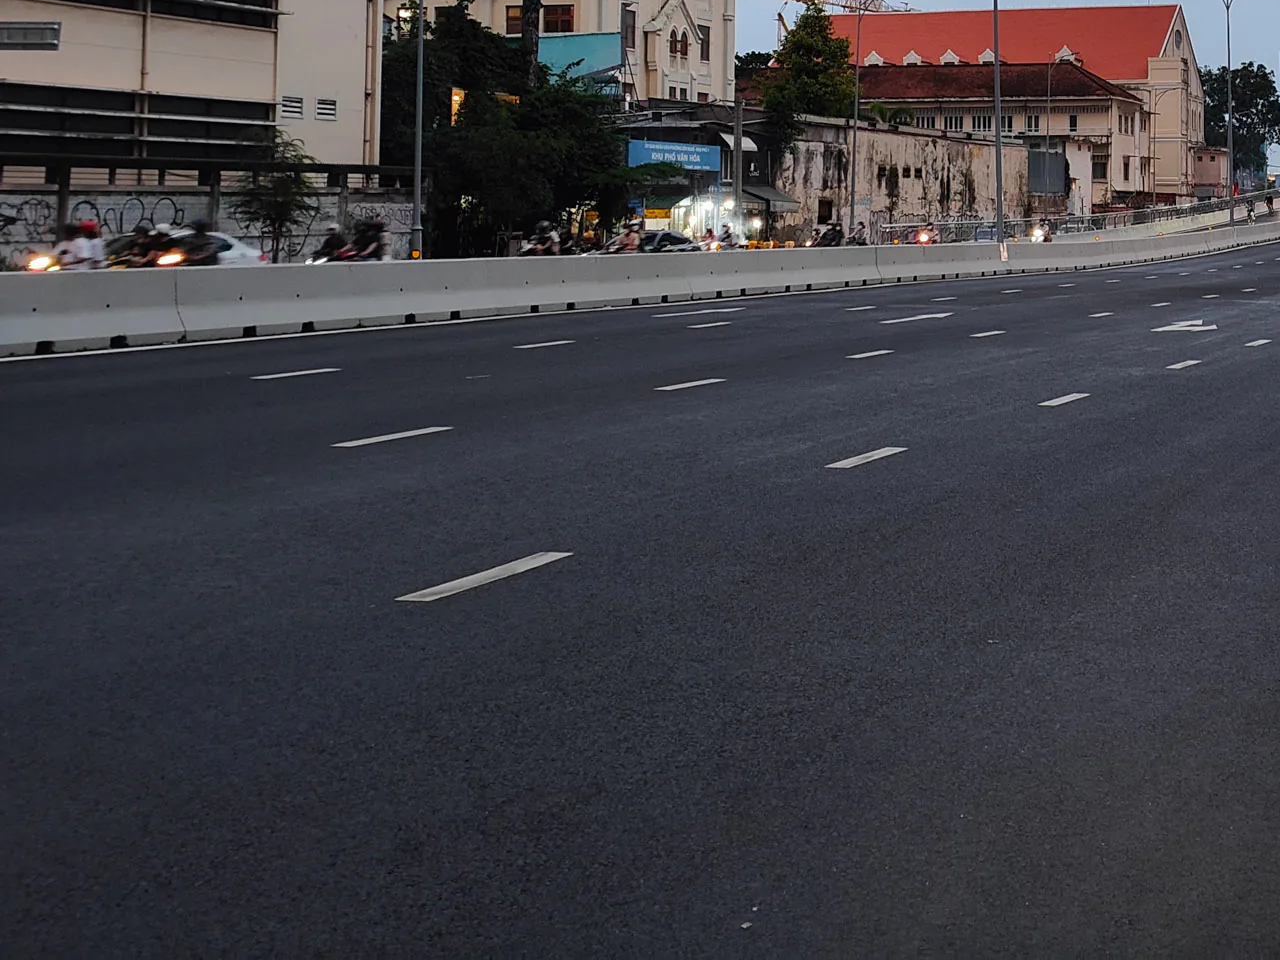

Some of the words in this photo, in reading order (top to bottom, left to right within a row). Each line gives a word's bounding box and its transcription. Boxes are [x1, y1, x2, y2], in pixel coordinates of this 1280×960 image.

[651, 152, 663, 160] KHU
[664, 151, 676, 161] PHỐ
[677, 152, 688, 161] VĂN
[689, 153, 701, 162] HÓA
